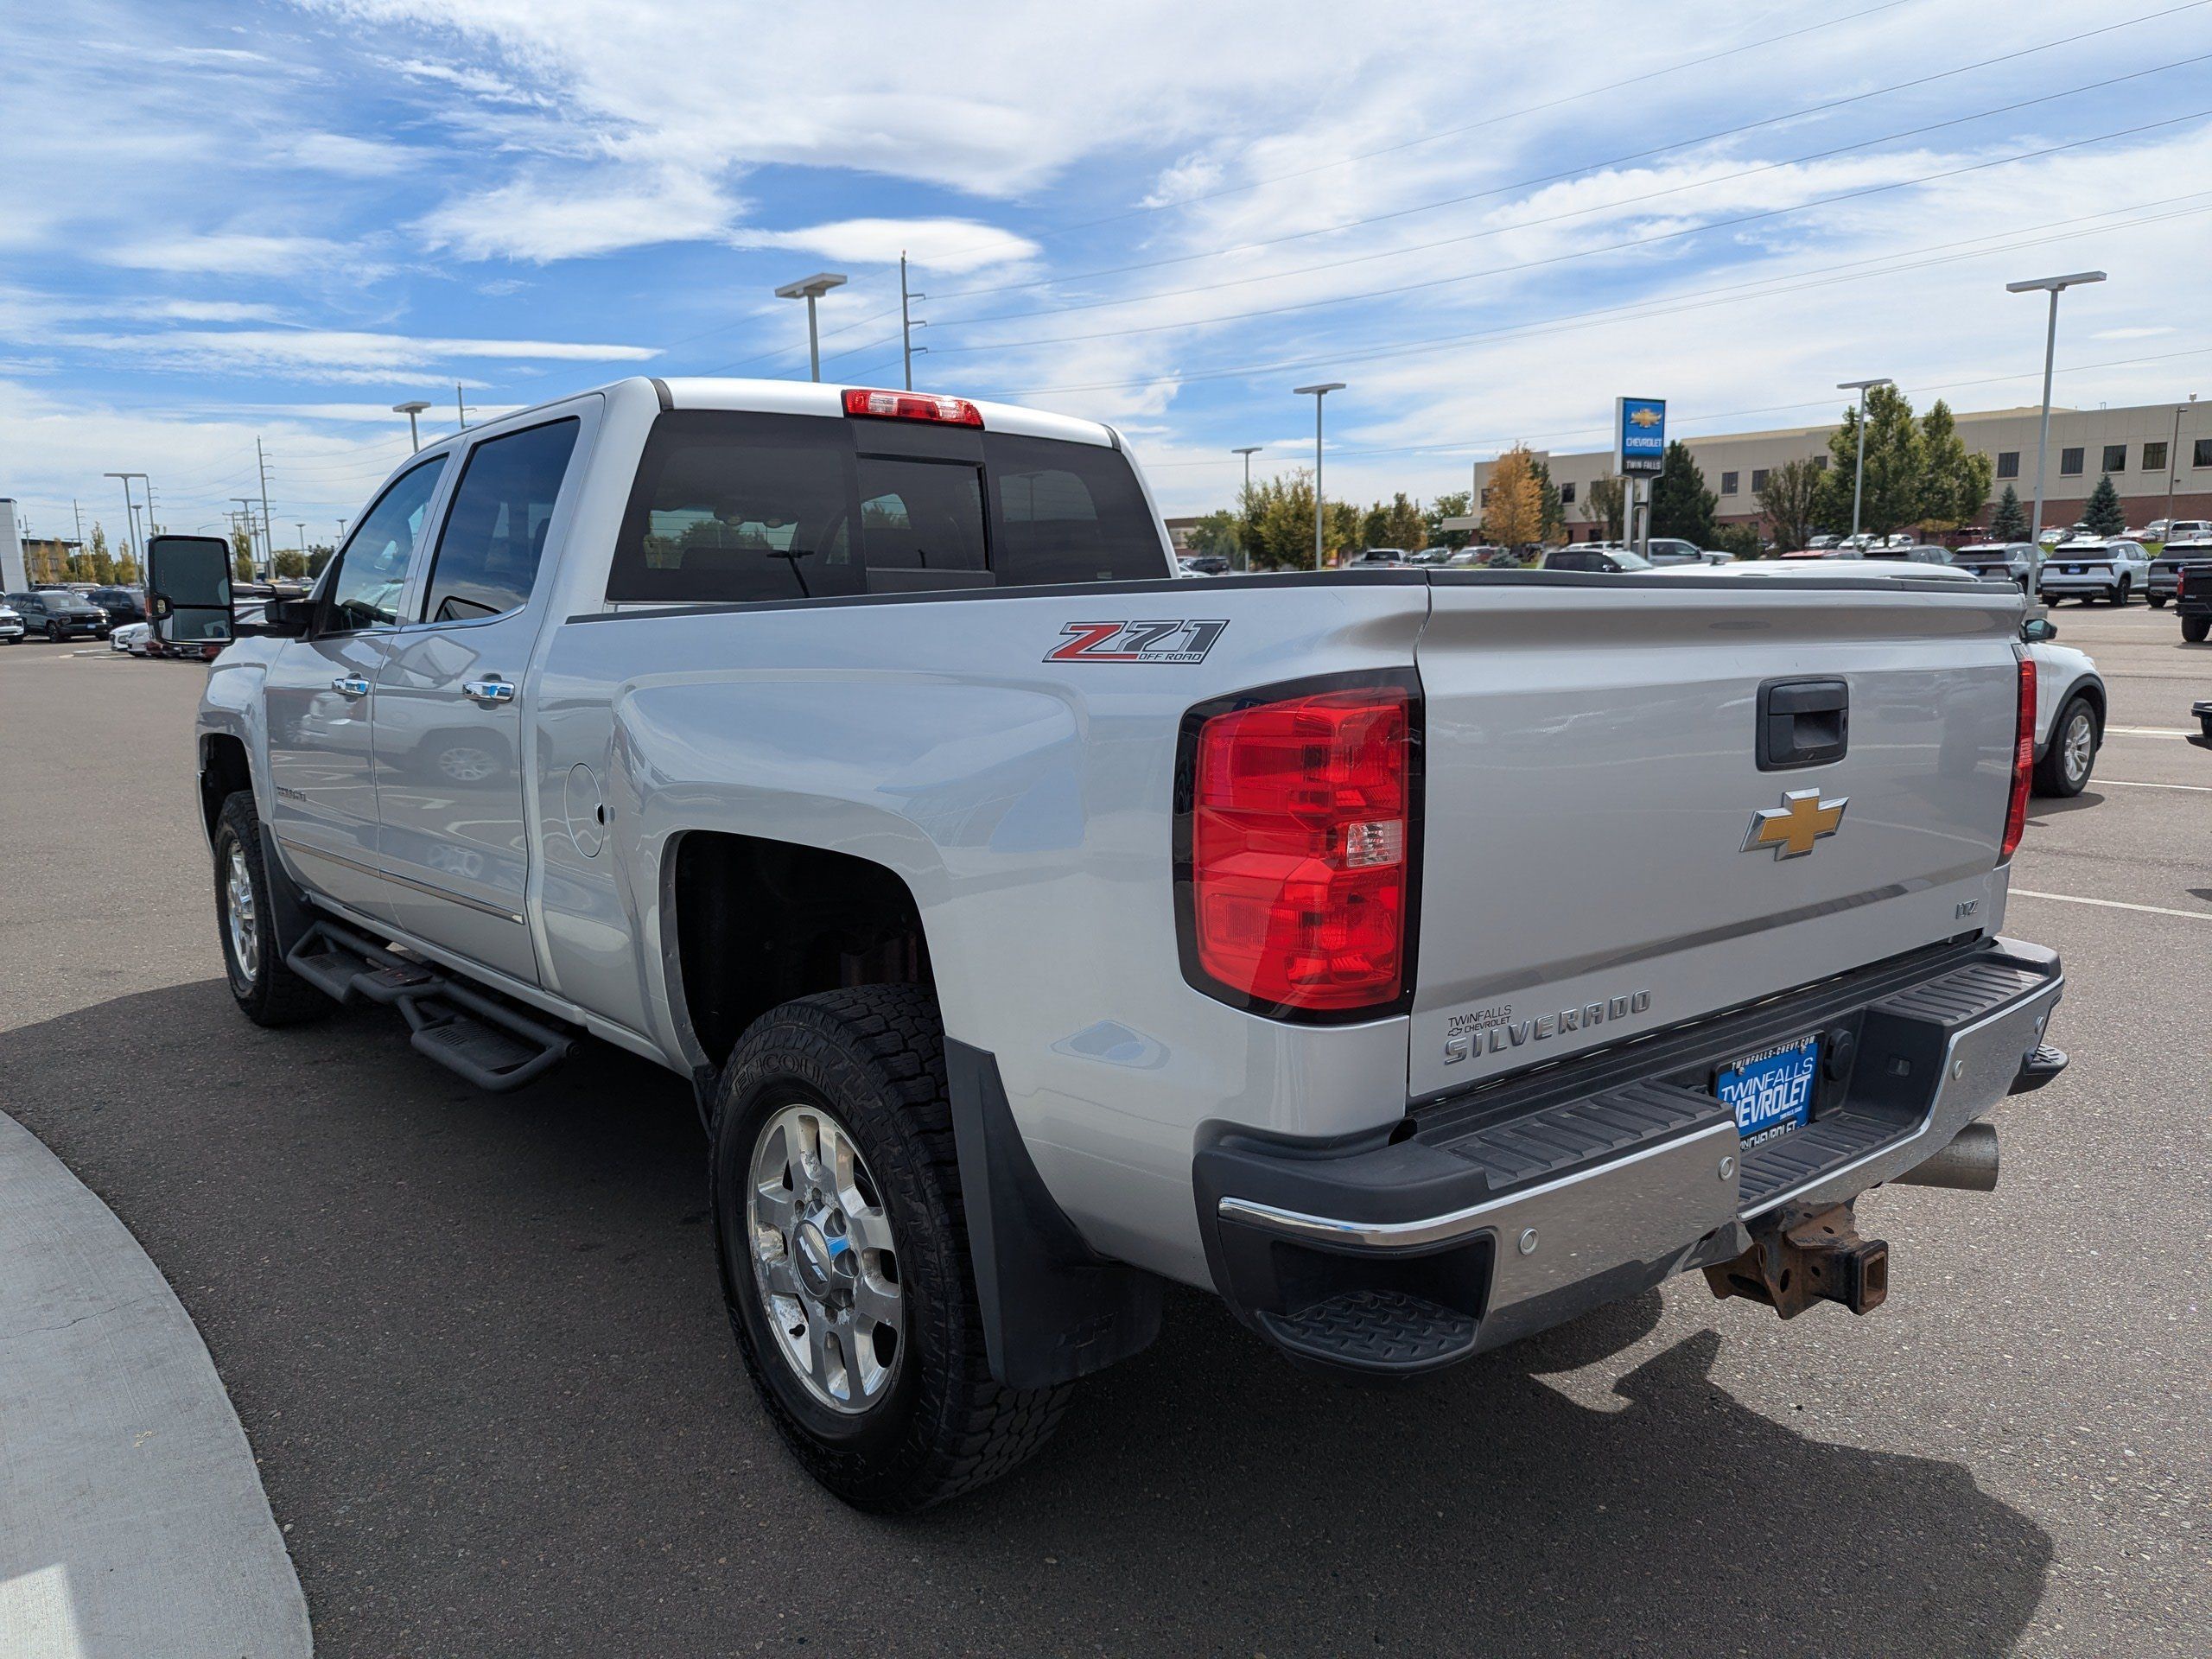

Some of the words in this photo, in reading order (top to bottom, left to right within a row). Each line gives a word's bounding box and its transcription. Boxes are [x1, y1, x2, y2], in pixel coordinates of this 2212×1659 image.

[1625, 437, 1662, 448] CHEVROLET
[1626, 461, 1642, 469] TWIN
[1643, 461, 1662, 470] FALLS
[1042, 620, 1230, 664] Z71
[1444, 989, 1651, 1065] SILVERADO
[1447, 1004, 1512, 1027] TWINFALLS
[1464, 1015, 1511, 1033] CHEVROLET
[1732, 1035, 1815, 1071] TWINFALLS-CHEVY.COM
[1721, 1057, 1814, 1102] TWINFALLS
